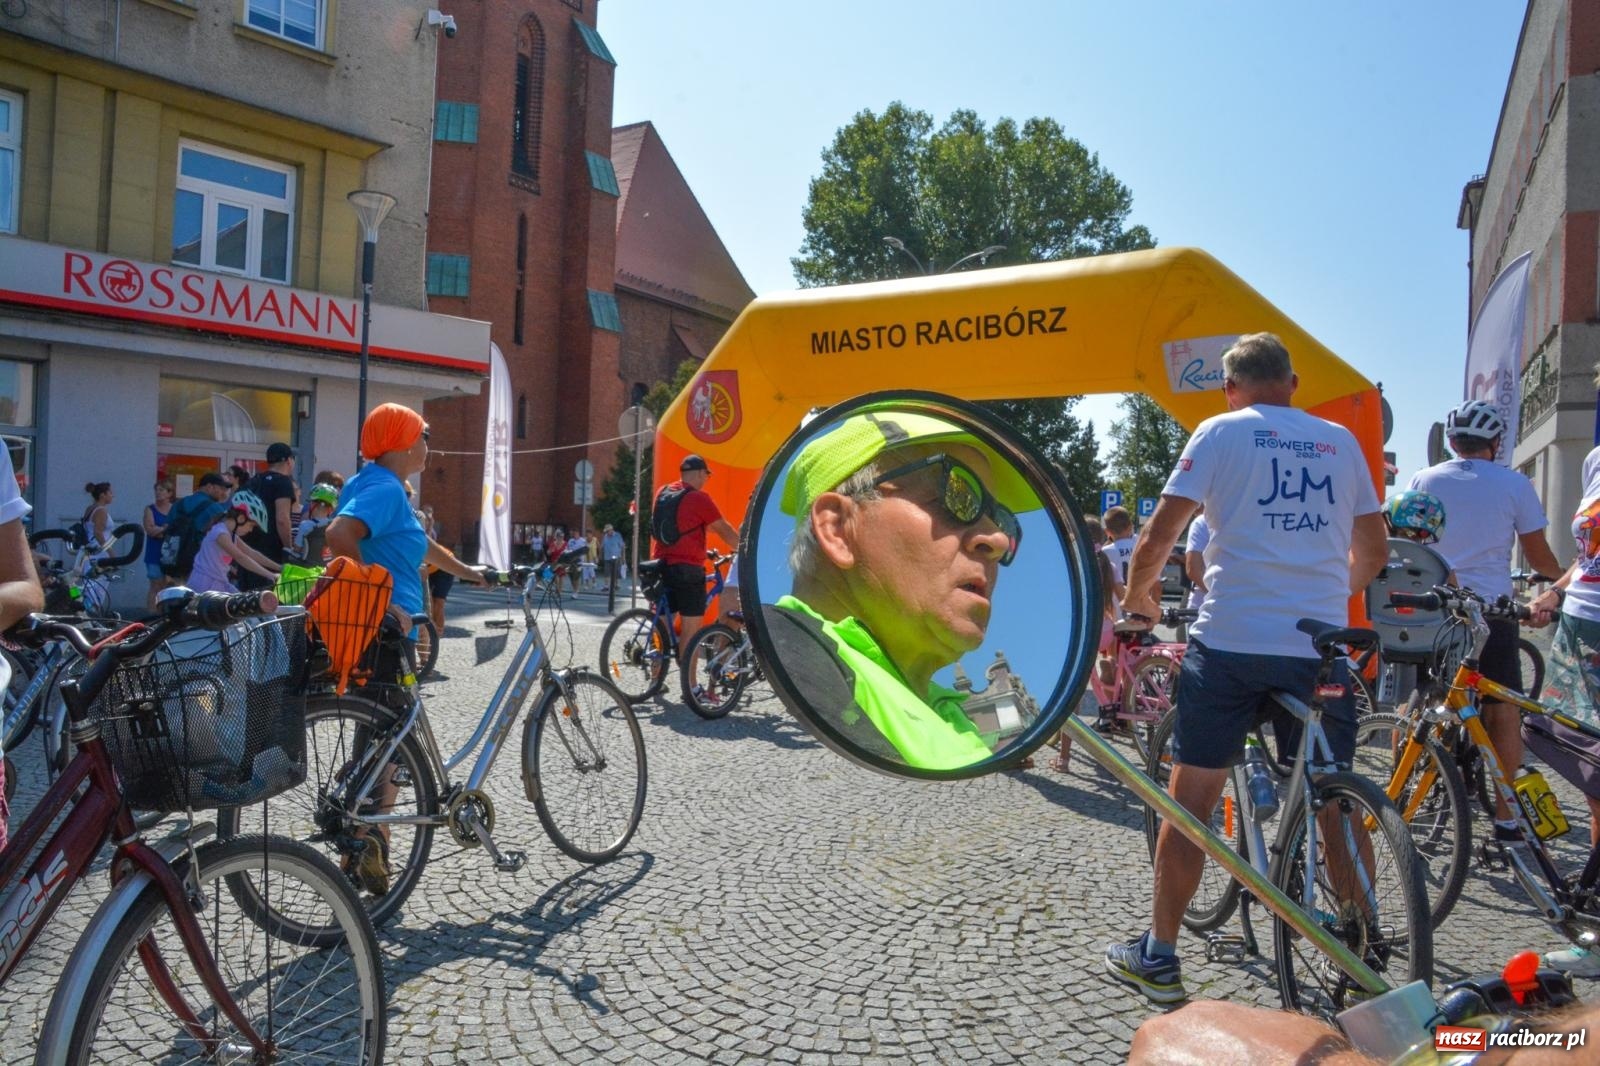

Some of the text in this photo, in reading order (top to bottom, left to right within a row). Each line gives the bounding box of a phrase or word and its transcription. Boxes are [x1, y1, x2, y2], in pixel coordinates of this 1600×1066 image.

[63, 252, 357, 338] ROSSMANN
[811, 306, 1068, 354] MIASTO RACIBÓRZ
[1255, 438, 1336, 456] ROWERON
[1295, 451, 1321, 459] 2024
[1106, 493, 1118, 509] P
[1143, 500, 1153, 514] P
